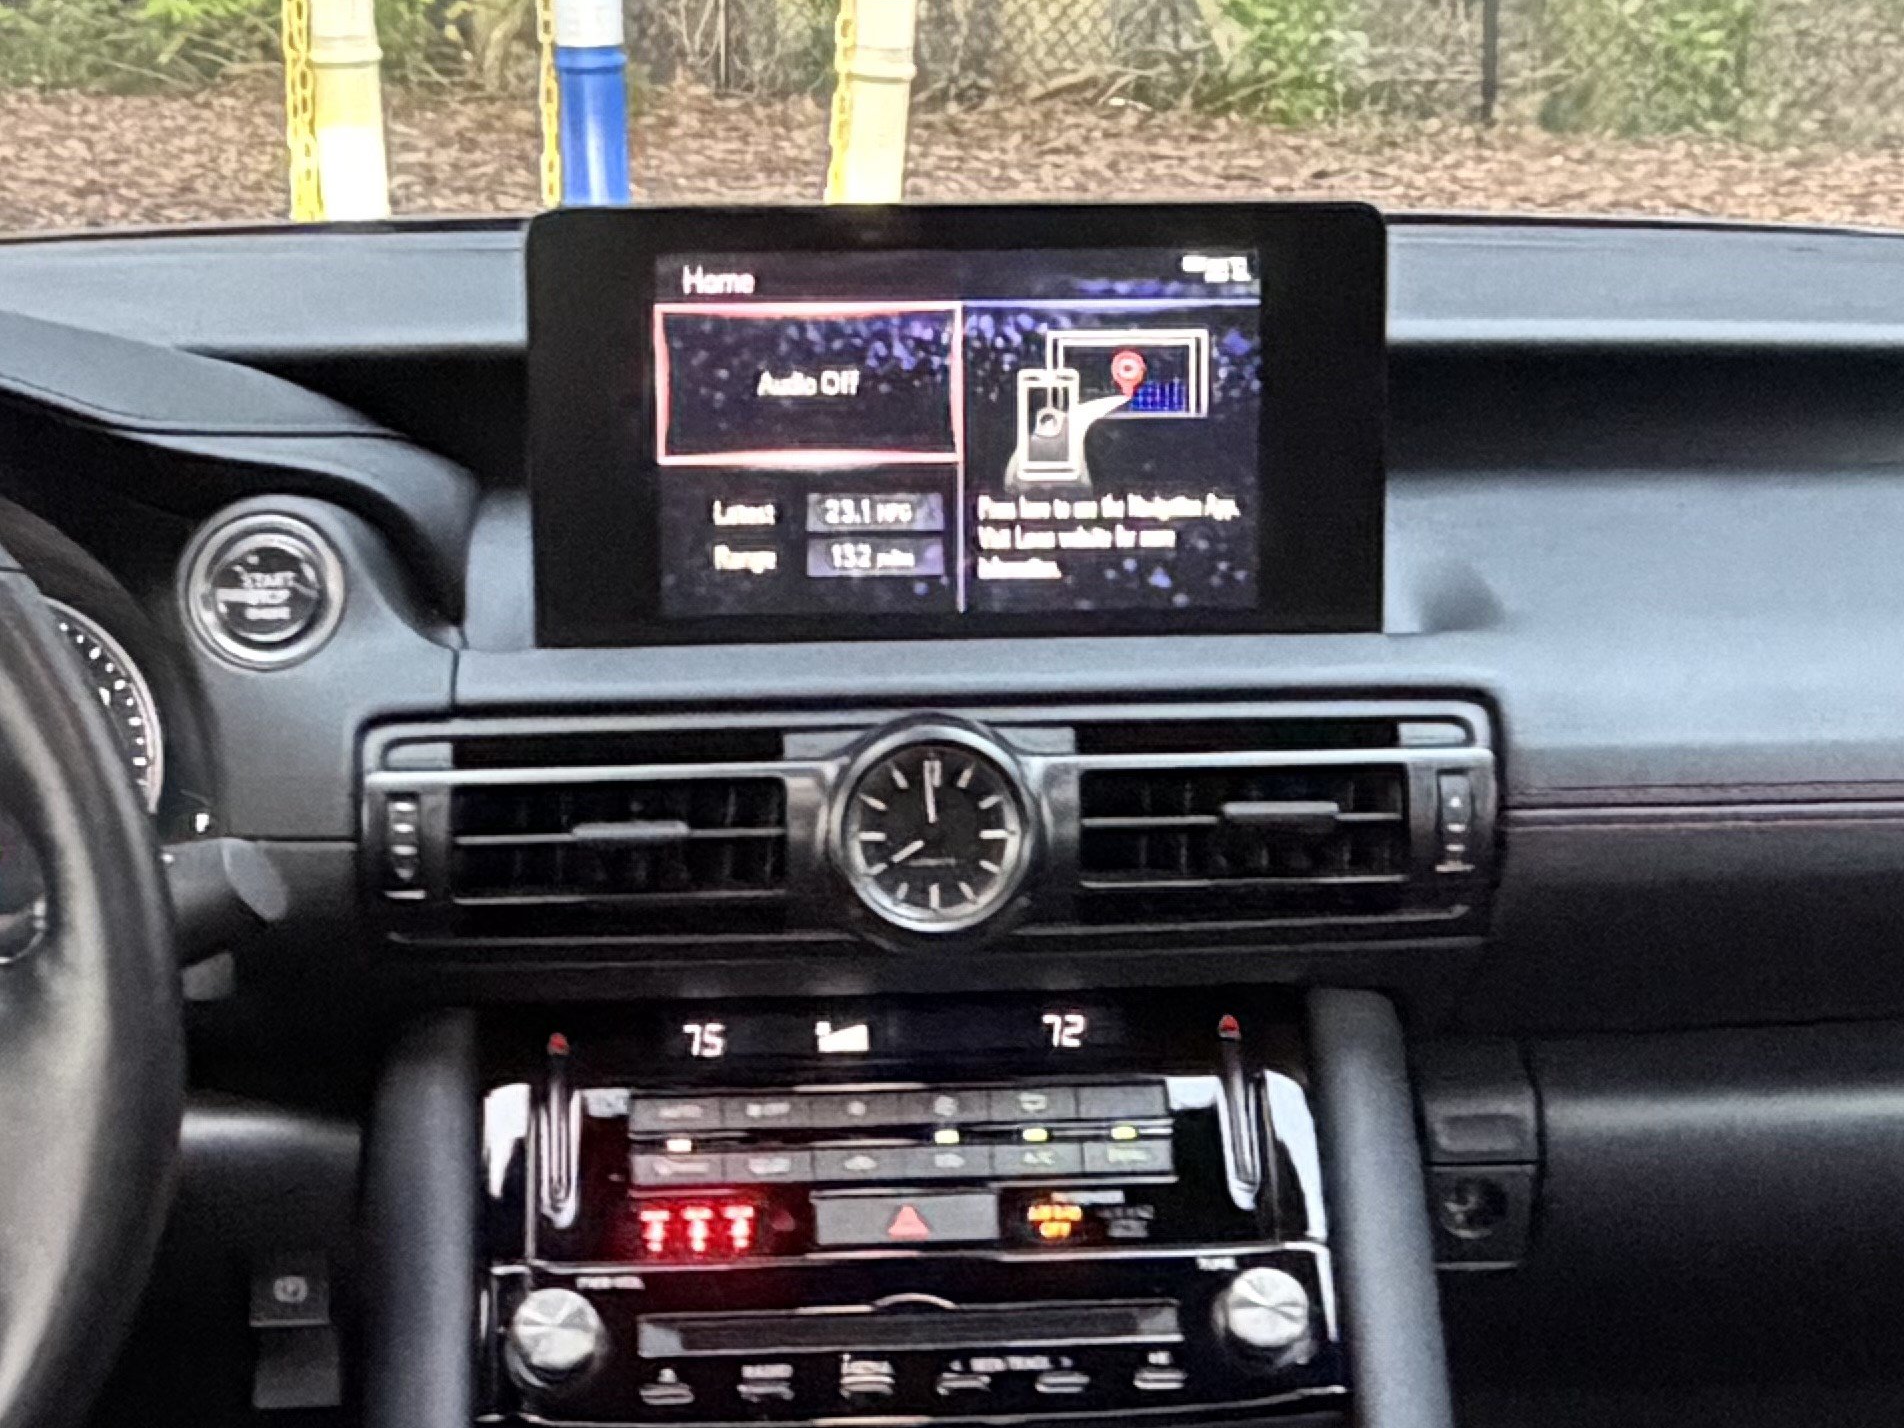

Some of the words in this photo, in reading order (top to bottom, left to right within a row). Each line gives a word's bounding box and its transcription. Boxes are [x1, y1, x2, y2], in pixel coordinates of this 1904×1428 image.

[681, 264, 756, 295] Home
[819, 368, 862, 397] Off
[681, 1022, 727, 1058] 75
[1040, 1012, 1087, 1049] 72
